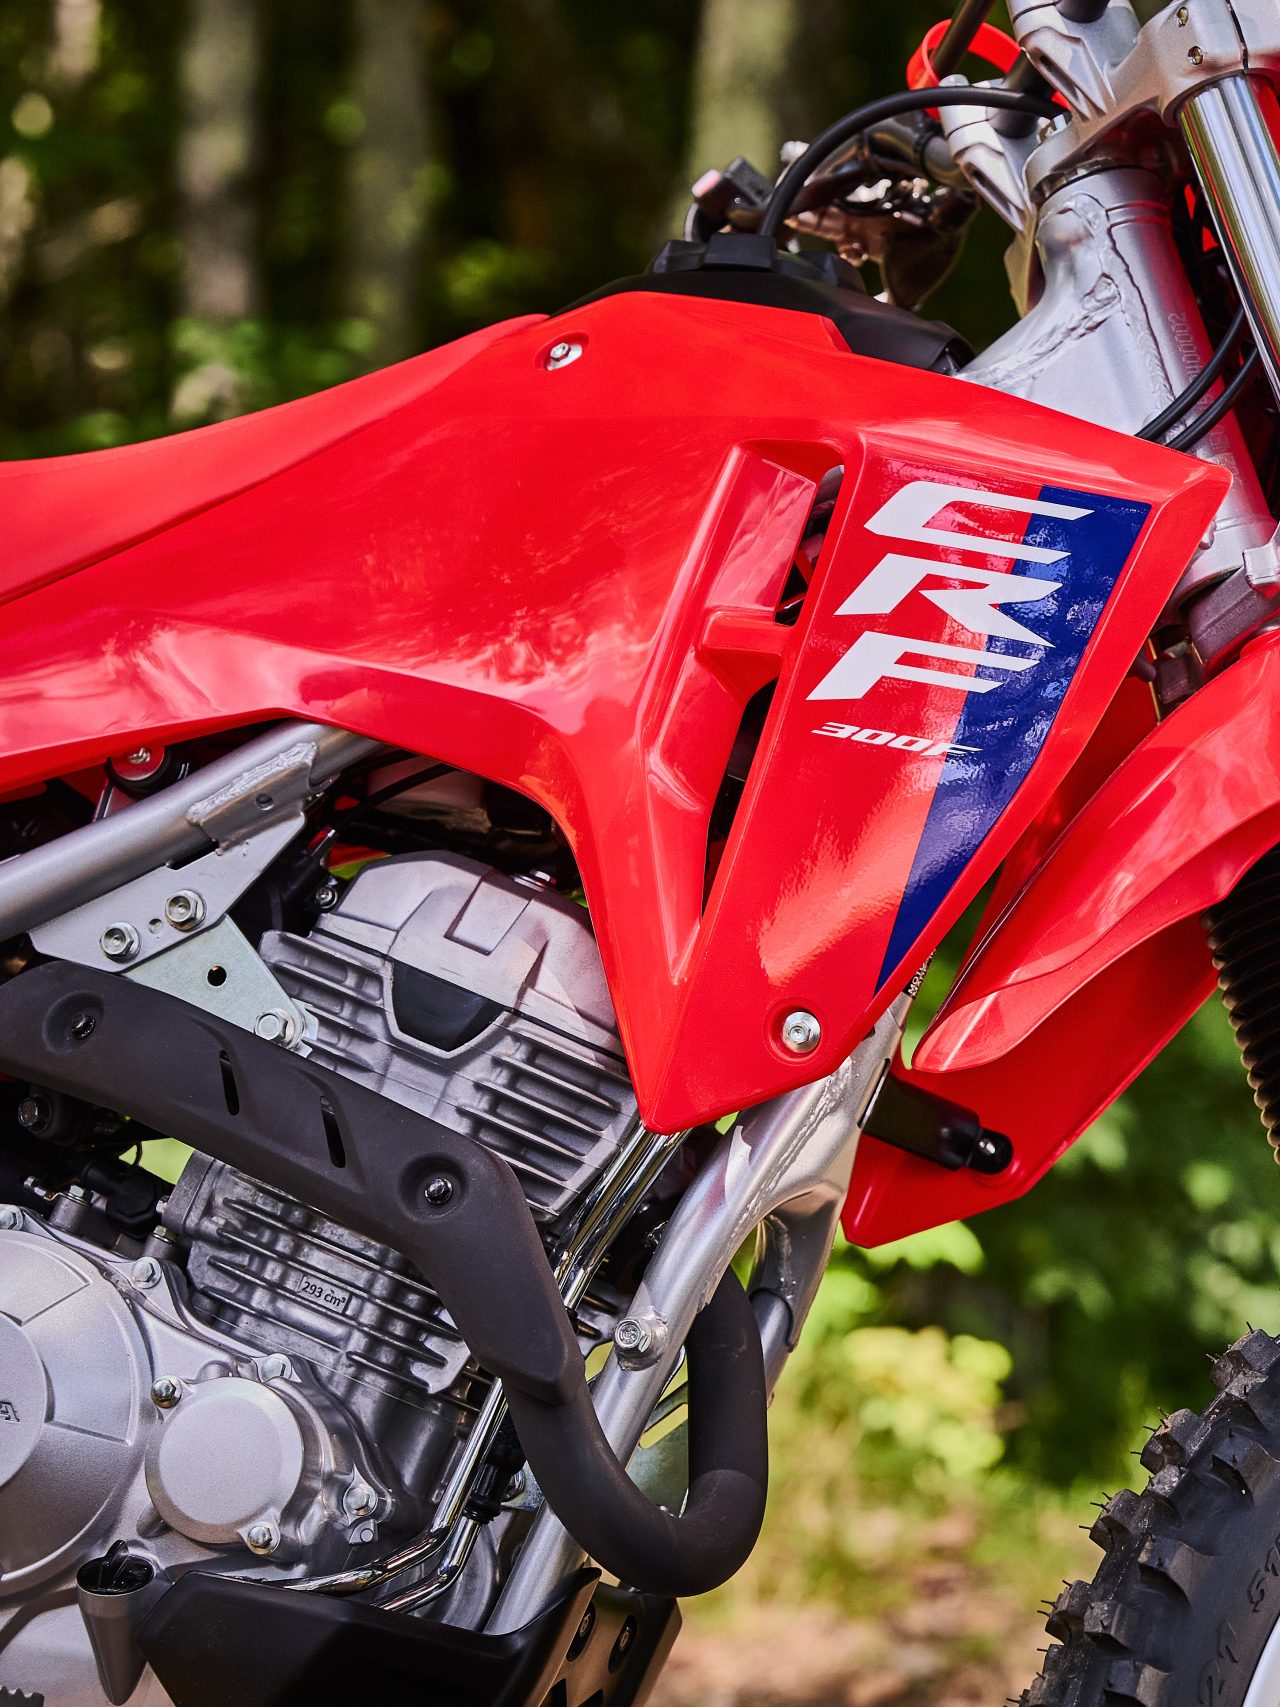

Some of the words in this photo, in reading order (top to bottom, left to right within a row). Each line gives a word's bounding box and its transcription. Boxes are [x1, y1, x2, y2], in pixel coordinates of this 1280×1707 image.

[805, 480, 1094, 700] CRF
[811, 722, 983, 757] 300F
[302, 1281, 323, 1298] 293
